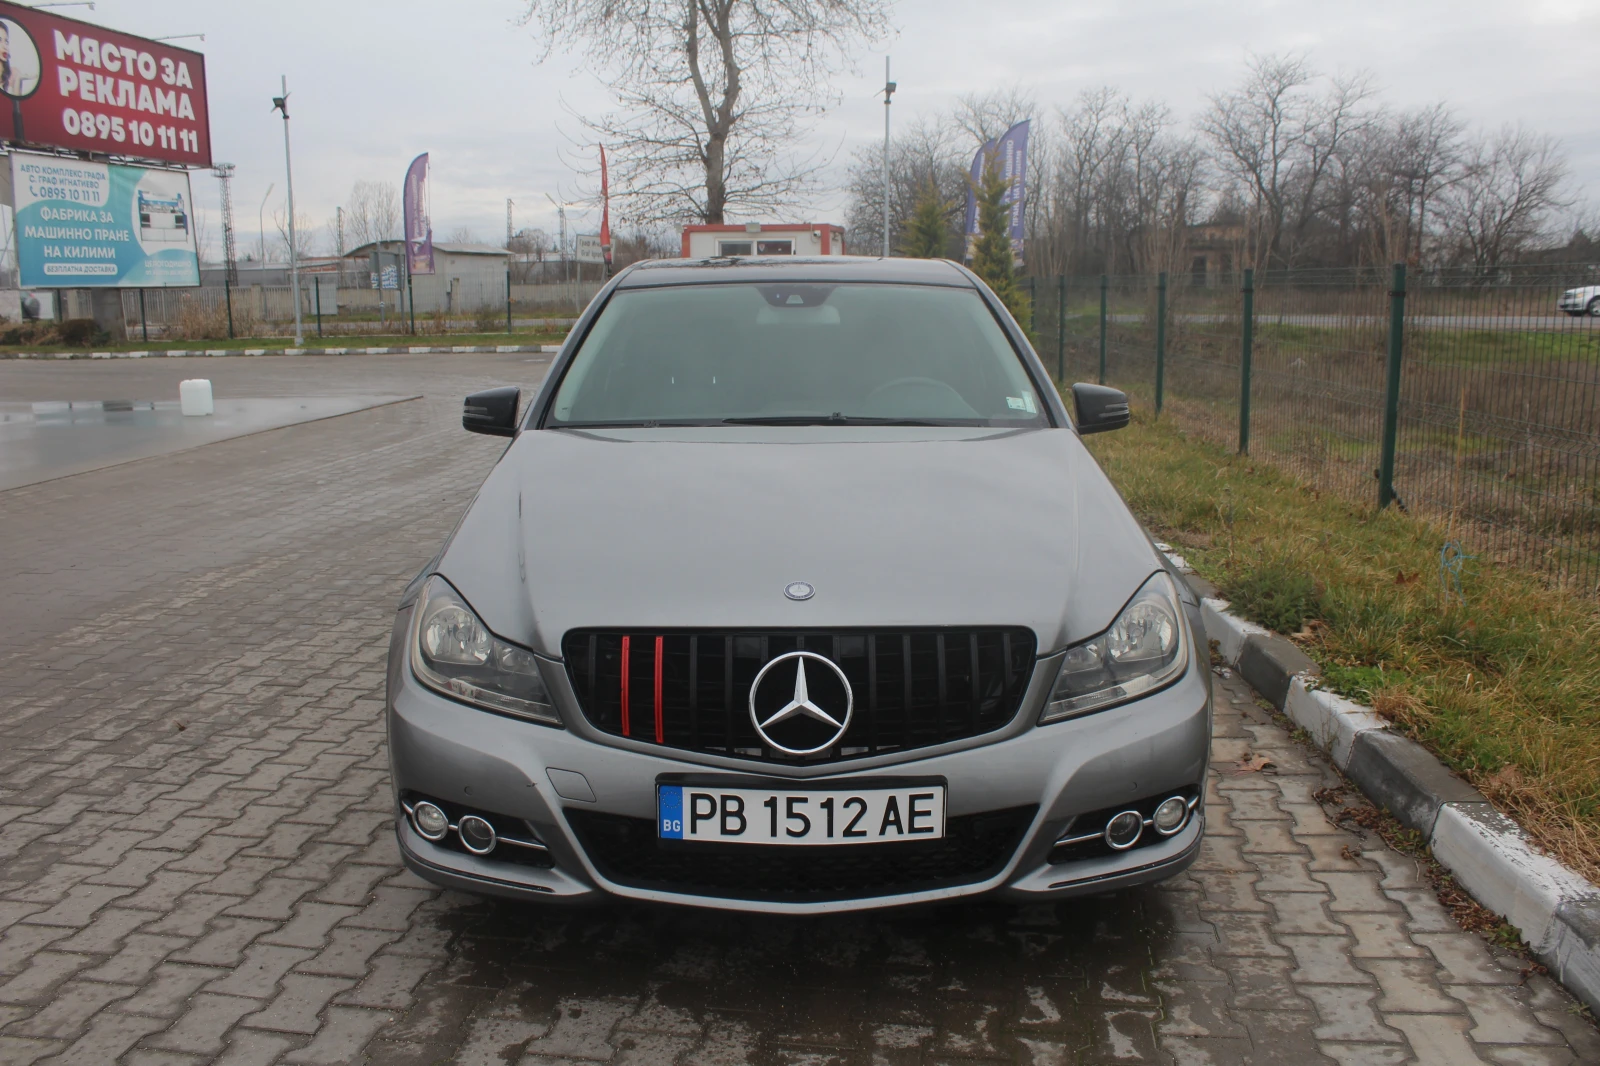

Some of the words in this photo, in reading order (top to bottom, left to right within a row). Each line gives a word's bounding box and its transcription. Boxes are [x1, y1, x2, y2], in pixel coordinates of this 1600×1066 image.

[53, 29, 157, 81] МЯСТО
[160, 57, 193, 89] ЗА
[57, 65, 196, 121] РЕКЛАМА
[62, 108, 126, 143] 0895
[128, 120, 154, 147] 10
[157, 125, 177, 150] 11
[179, 128, 198, 153] 11
[20, 164, 41, 173] АВТО
[42, 166, 83, 178] КОМПЛЕКС
[38, 175, 58, 185] ГРАФ
[59, 178, 100, 189] ИГНАТИЕВО
[40, 186, 67, 199] 0895
[68, 189, 80, 200] 10
[82, 190, 90, 201] 11
[92, 191, 100, 202] 11
[40, 206, 98, 222] ФАБРИКА
[100, 210, 114, 223] ЗА
[24, 225, 92, 240] МАШИННО
[94, 228, 130, 241] ПРАНЕ
[44, 245, 62, 258] НА
[64, 246, 116, 259] КИЛИМИ
[47, 265, 83, 273] БЕЗПЛАТНА
[84, 265, 116, 274] ДОСТАВКА
[690, 793, 747, 836] PB
[763, 796, 868, 838] 1512
[878, 793, 934, 836] AE
[663, 819, 681, 832] BG
